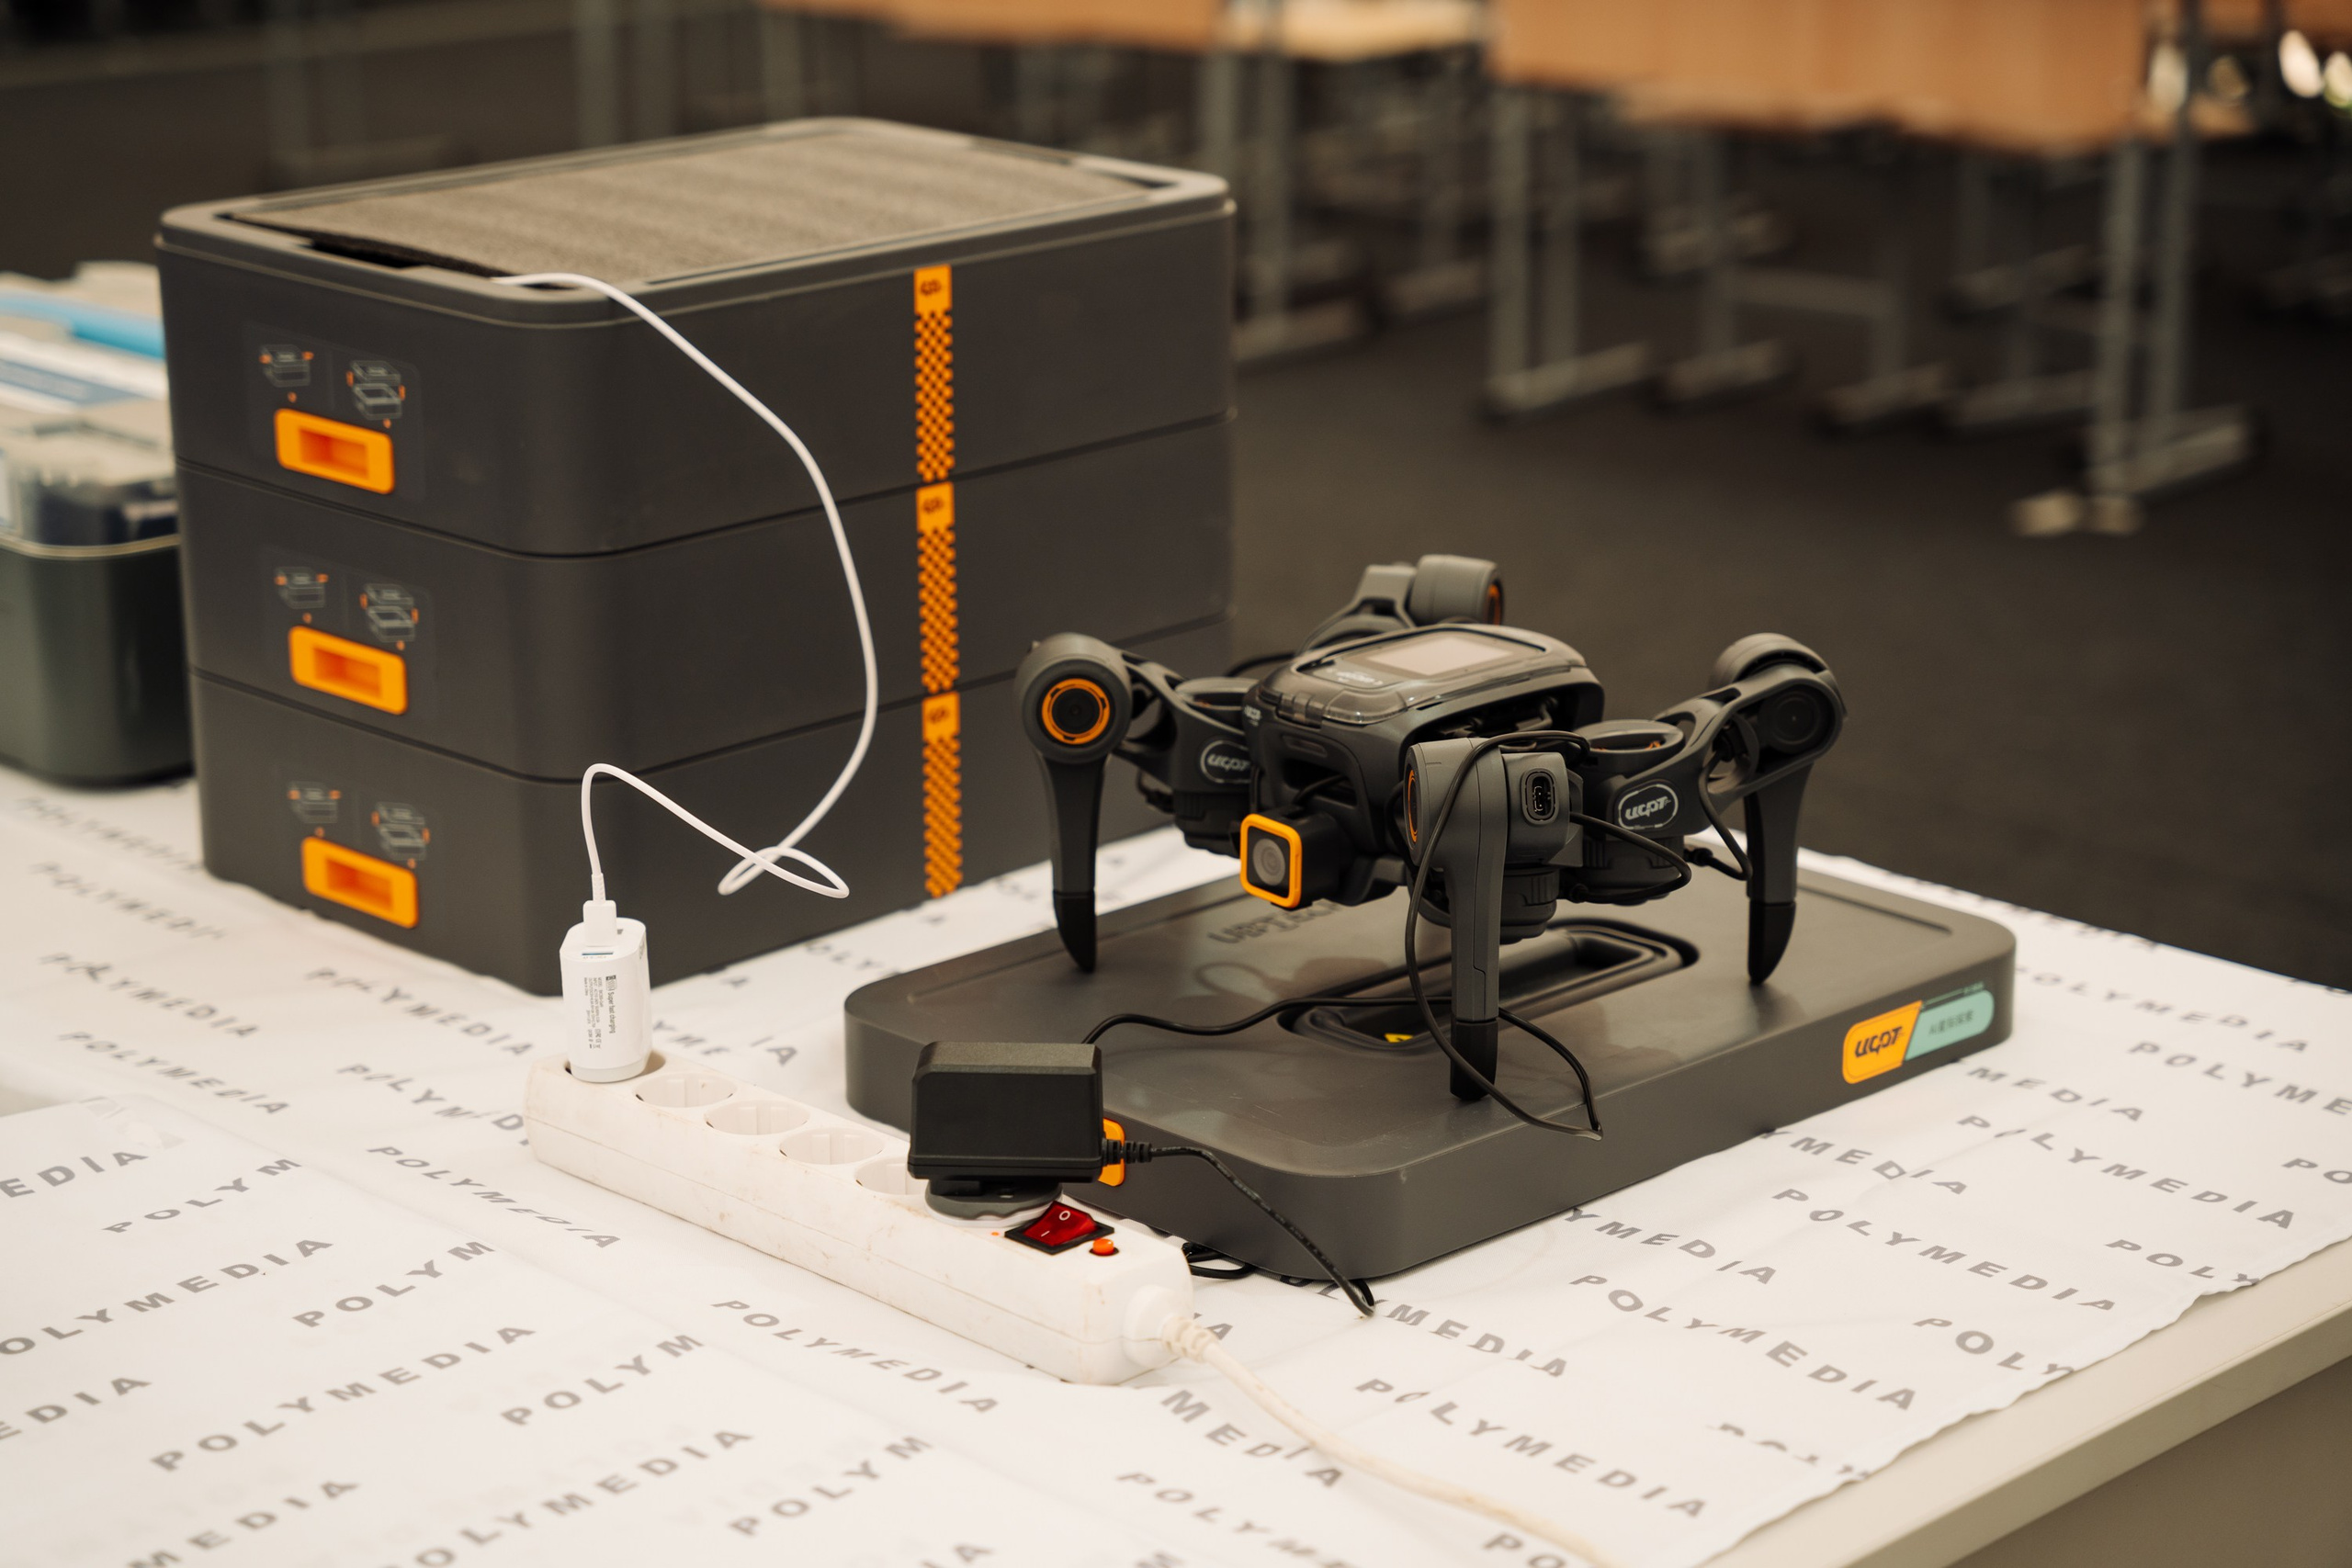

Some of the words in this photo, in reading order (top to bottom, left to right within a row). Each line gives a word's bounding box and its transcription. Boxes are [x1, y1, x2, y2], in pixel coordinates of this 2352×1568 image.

[57, 1030, 290, 1114] POLYMEDIA
[101, 1157, 303, 1234] POLYM
[1770, 1188, 2117, 1311] POLYMEDIA
[0, 1238, 334, 1356] OLYMEDIA
[291, 1240, 497, 1328] POLYM
[149, 1325, 537, 1472] POLYMEDIA
[500, 1333, 706, 1427] POLYM
[709, 1299, 1000, 1413] POLYMEDIA
[1567, 1274, 1917, 1412] POLYMEDIA
[728, 1436, 933, 1540] POLYM
[1159, 1388, 1344, 1489] MEDIA
[1354, 1377, 1708, 1517] POLYMEDIA
[377, 1430, 753, 1568] OLYMEDIA
